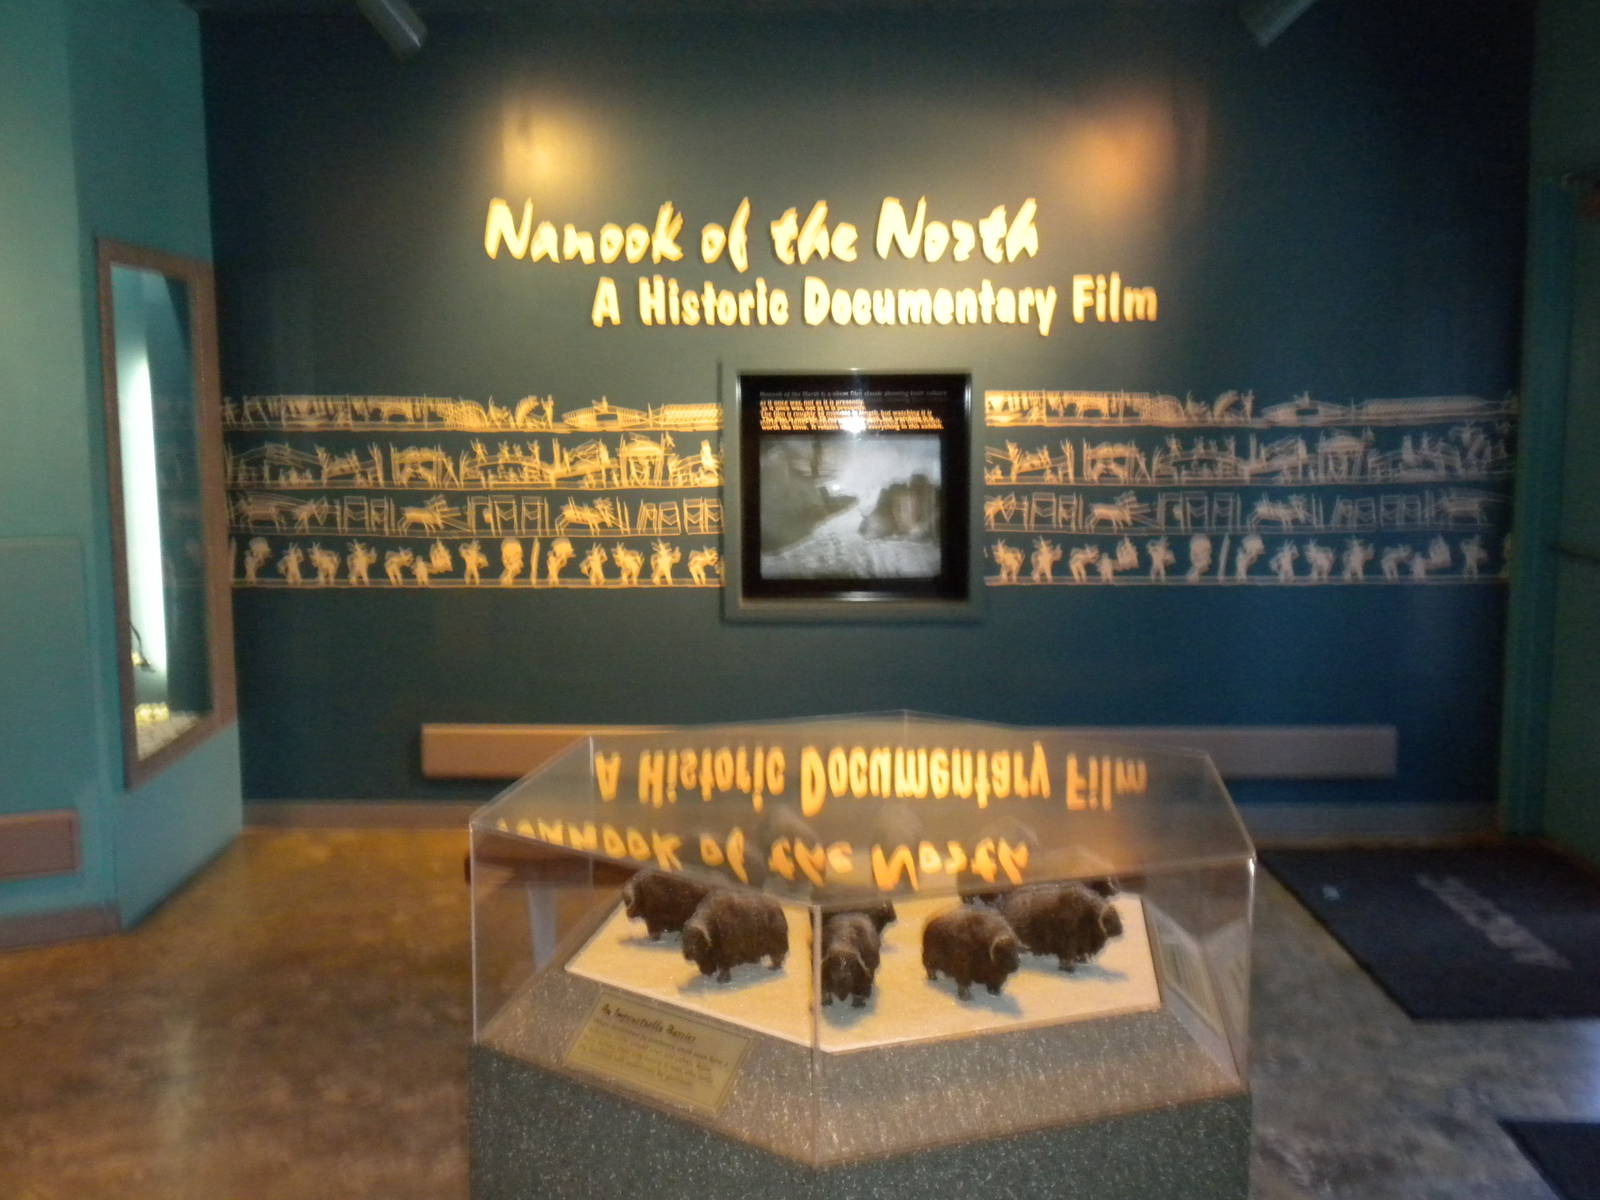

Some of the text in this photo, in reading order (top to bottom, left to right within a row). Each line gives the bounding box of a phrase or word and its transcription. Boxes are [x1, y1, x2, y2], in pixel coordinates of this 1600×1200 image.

[484, 196, 1039, 273] Nanook of the North
[592, 274, 1157, 337] A Historic Documentary Film
